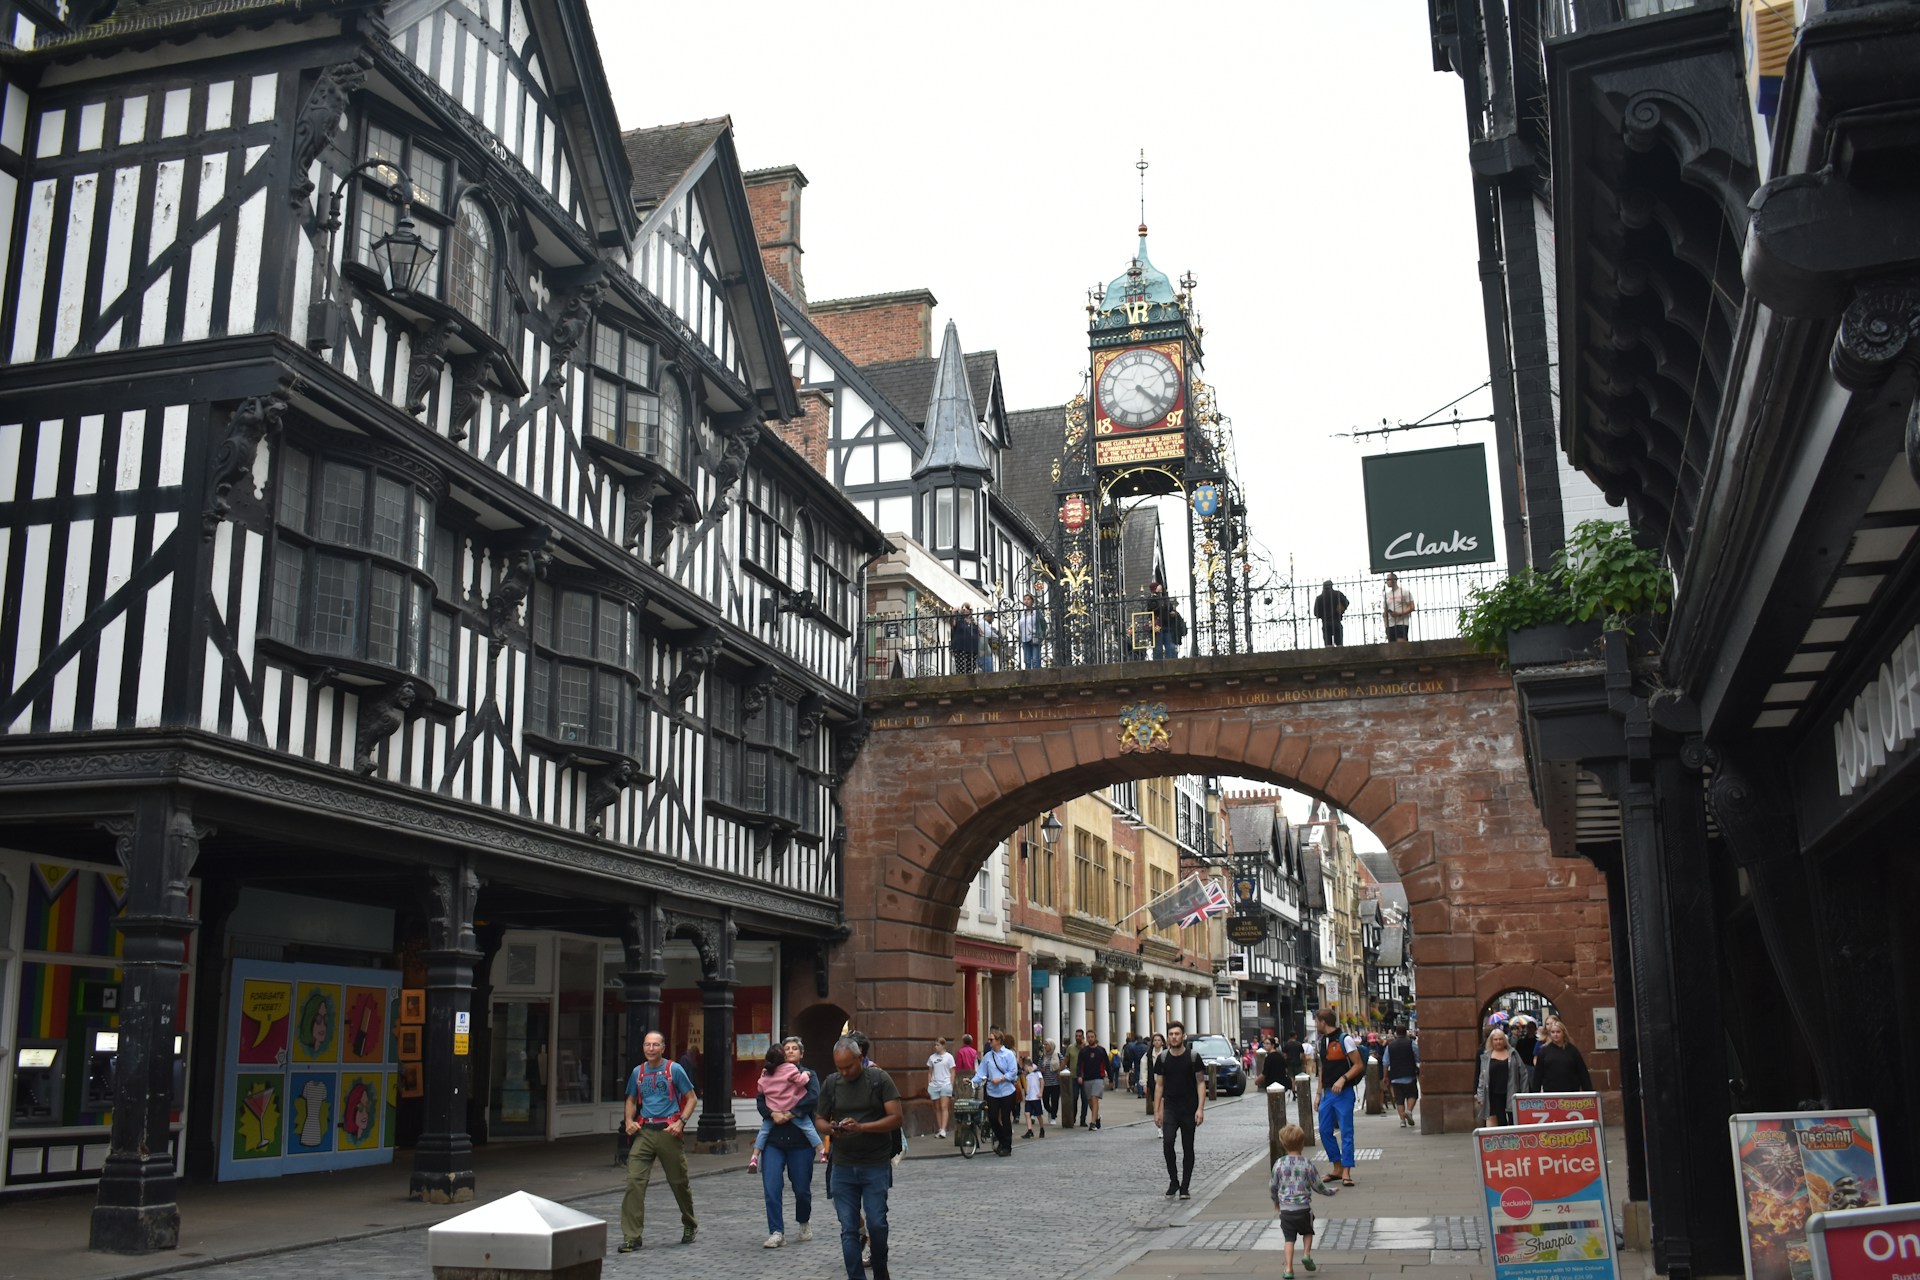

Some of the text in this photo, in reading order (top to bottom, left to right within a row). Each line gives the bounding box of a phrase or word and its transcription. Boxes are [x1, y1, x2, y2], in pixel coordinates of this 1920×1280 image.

[1097, 409, 1184, 434] 18 97
[1384, 529, 1478, 560] Clarks
[1240, 692, 1269, 705] LORD
[1277, 685, 1348, 702] GROSVENOR
[949, 712, 965, 723] AT
[980, 711, 1002, 722] THE
[1834, 681, 1886, 797] POST
[250, 991, 286, 1000] FOREGATE
[1519, 1098, 1596, 1110] BACK TO SCHOOL
[1482, 1129, 1592, 1152] BACK TO SCHOOL
[1801, 1130, 1851, 1144] OBSIDIAN
[1808, 1142, 1847, 1150] FLAMES
[1486, 1154, 1595, 1179] Half Price
[1501, 1200, 1531, 1208] Exclusive
[1557, 1204, 1571, 1214] 24
[1524, 1233, 1577, 1255] Sharpie
[1500, 1254, 1510, 1263] 10
